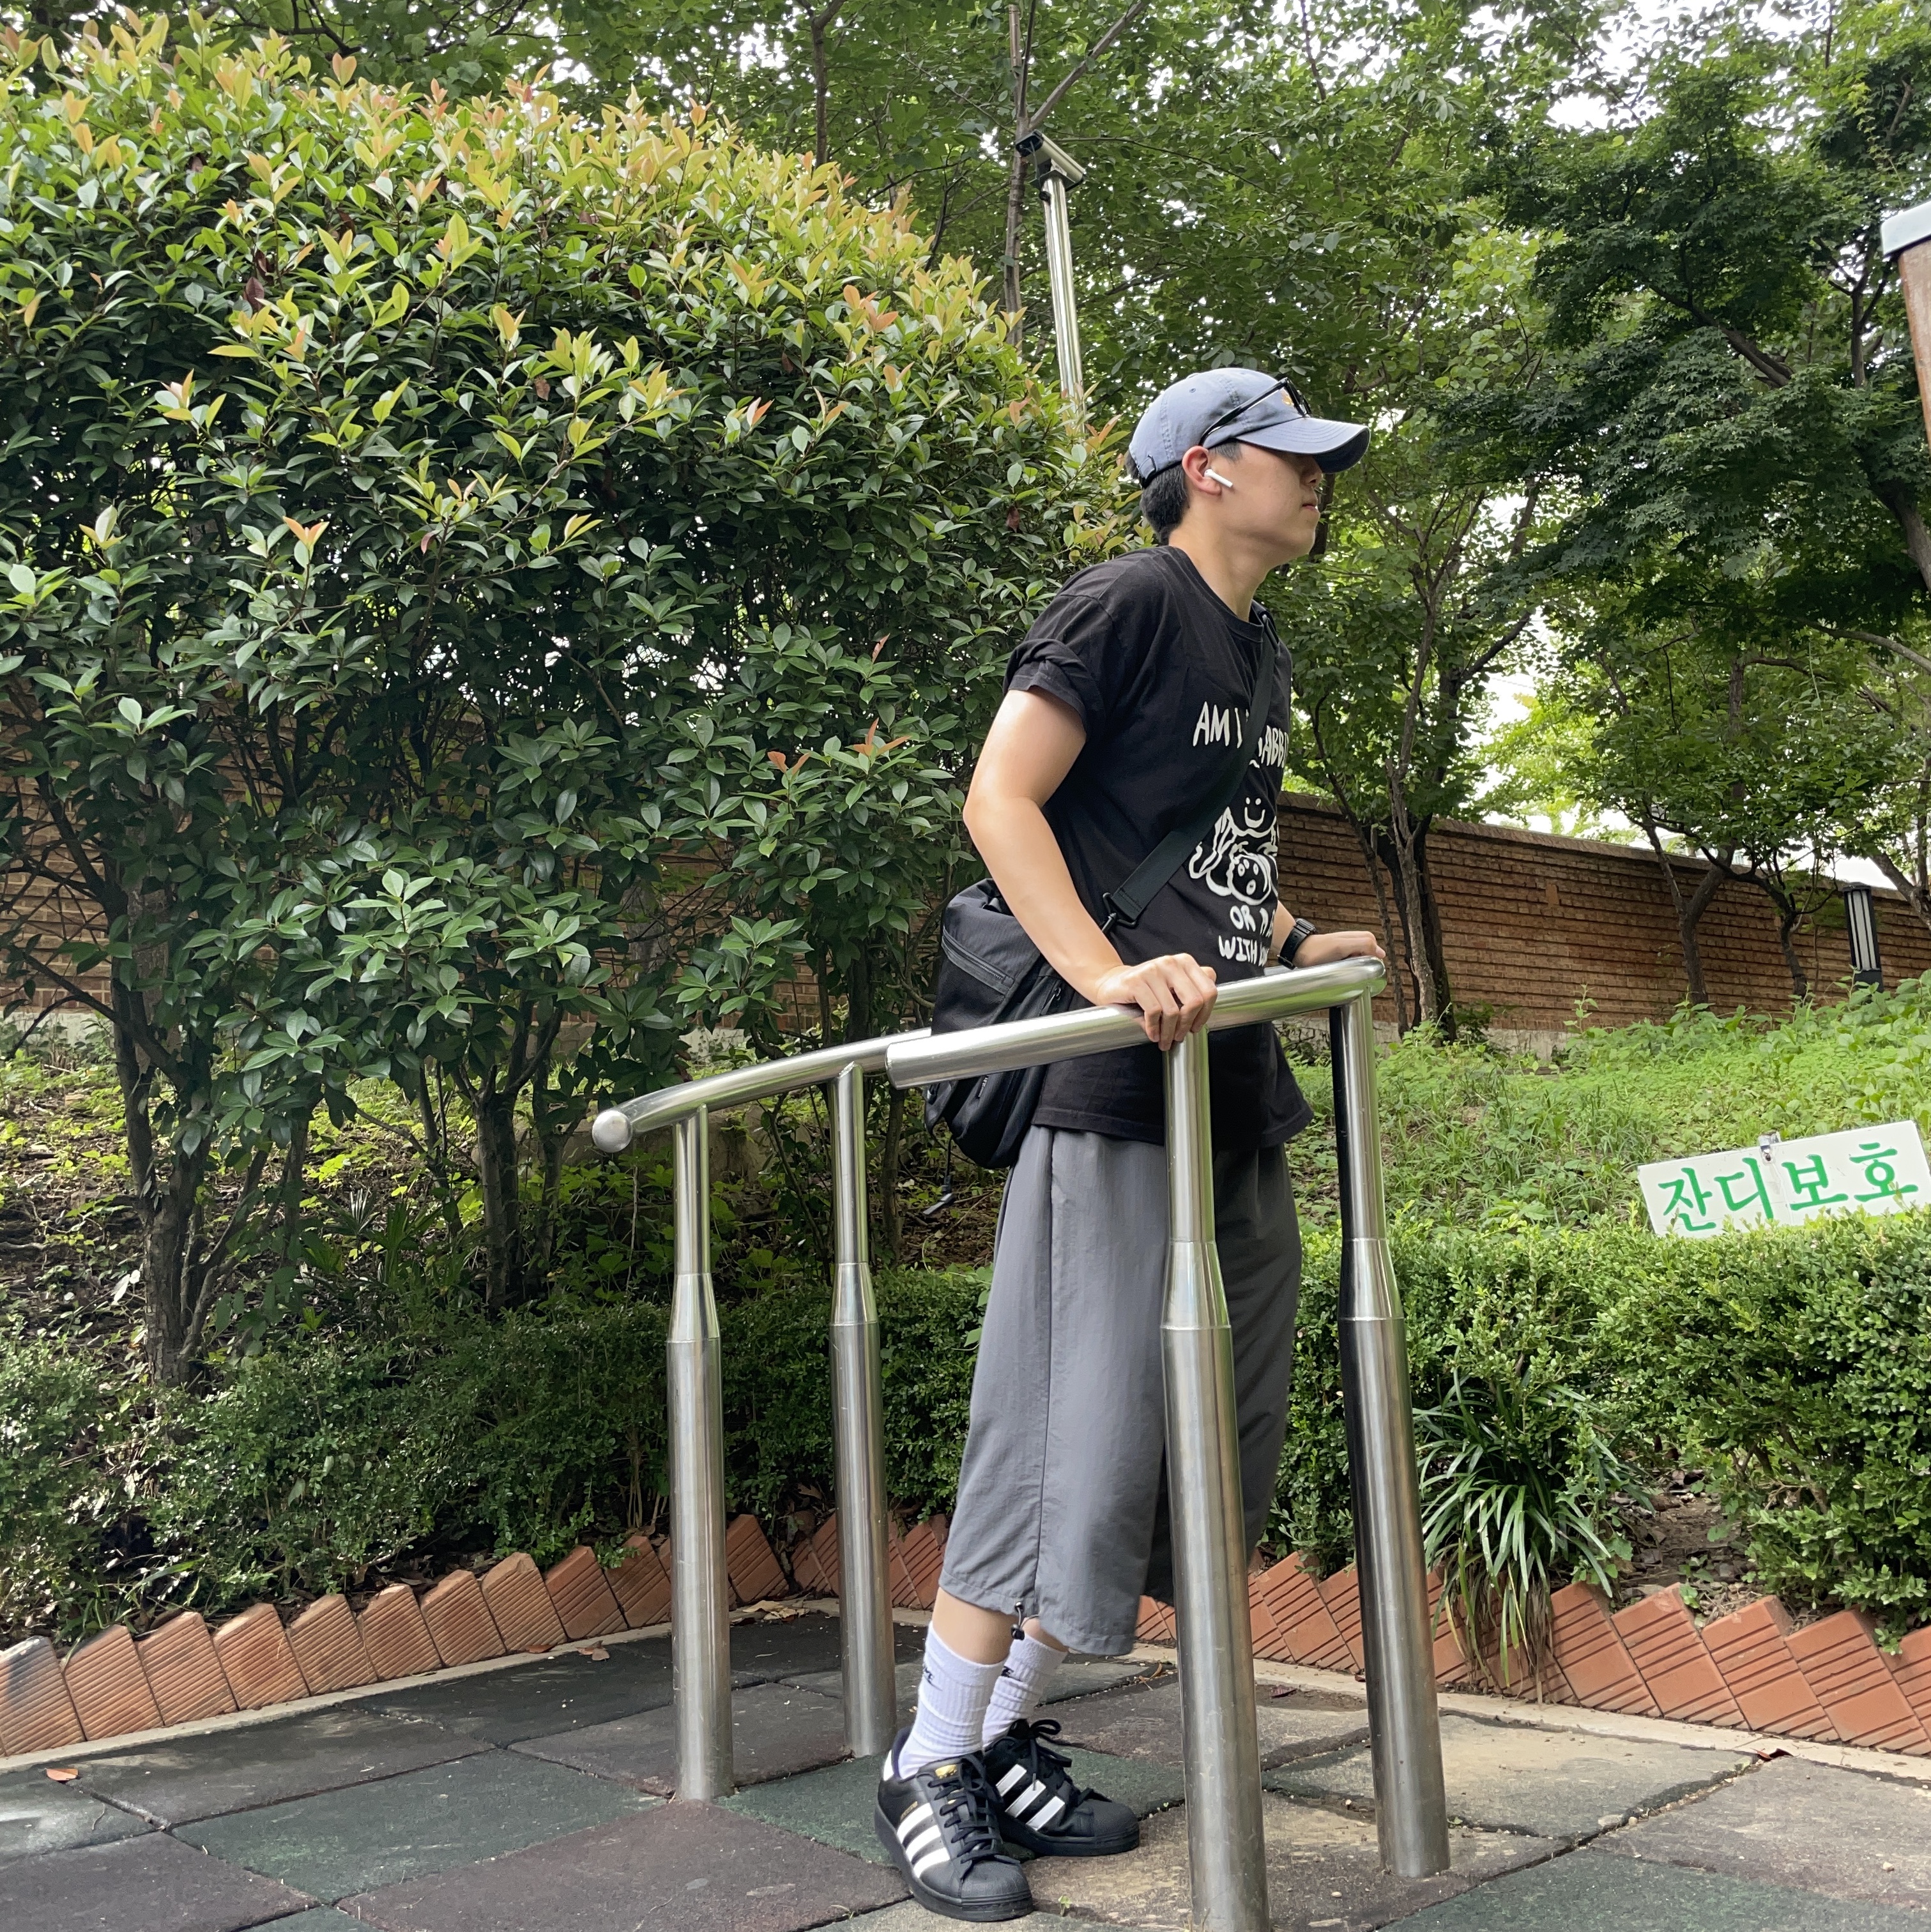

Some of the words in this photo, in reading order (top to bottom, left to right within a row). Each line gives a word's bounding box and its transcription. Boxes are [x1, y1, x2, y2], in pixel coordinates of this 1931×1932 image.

[1193, 701, 1230, 747] AM
[1234, 707, 1242, 749] I
[1230, 904, 1256, 932] OR
[1218, 934, 1258, 964] WITH
